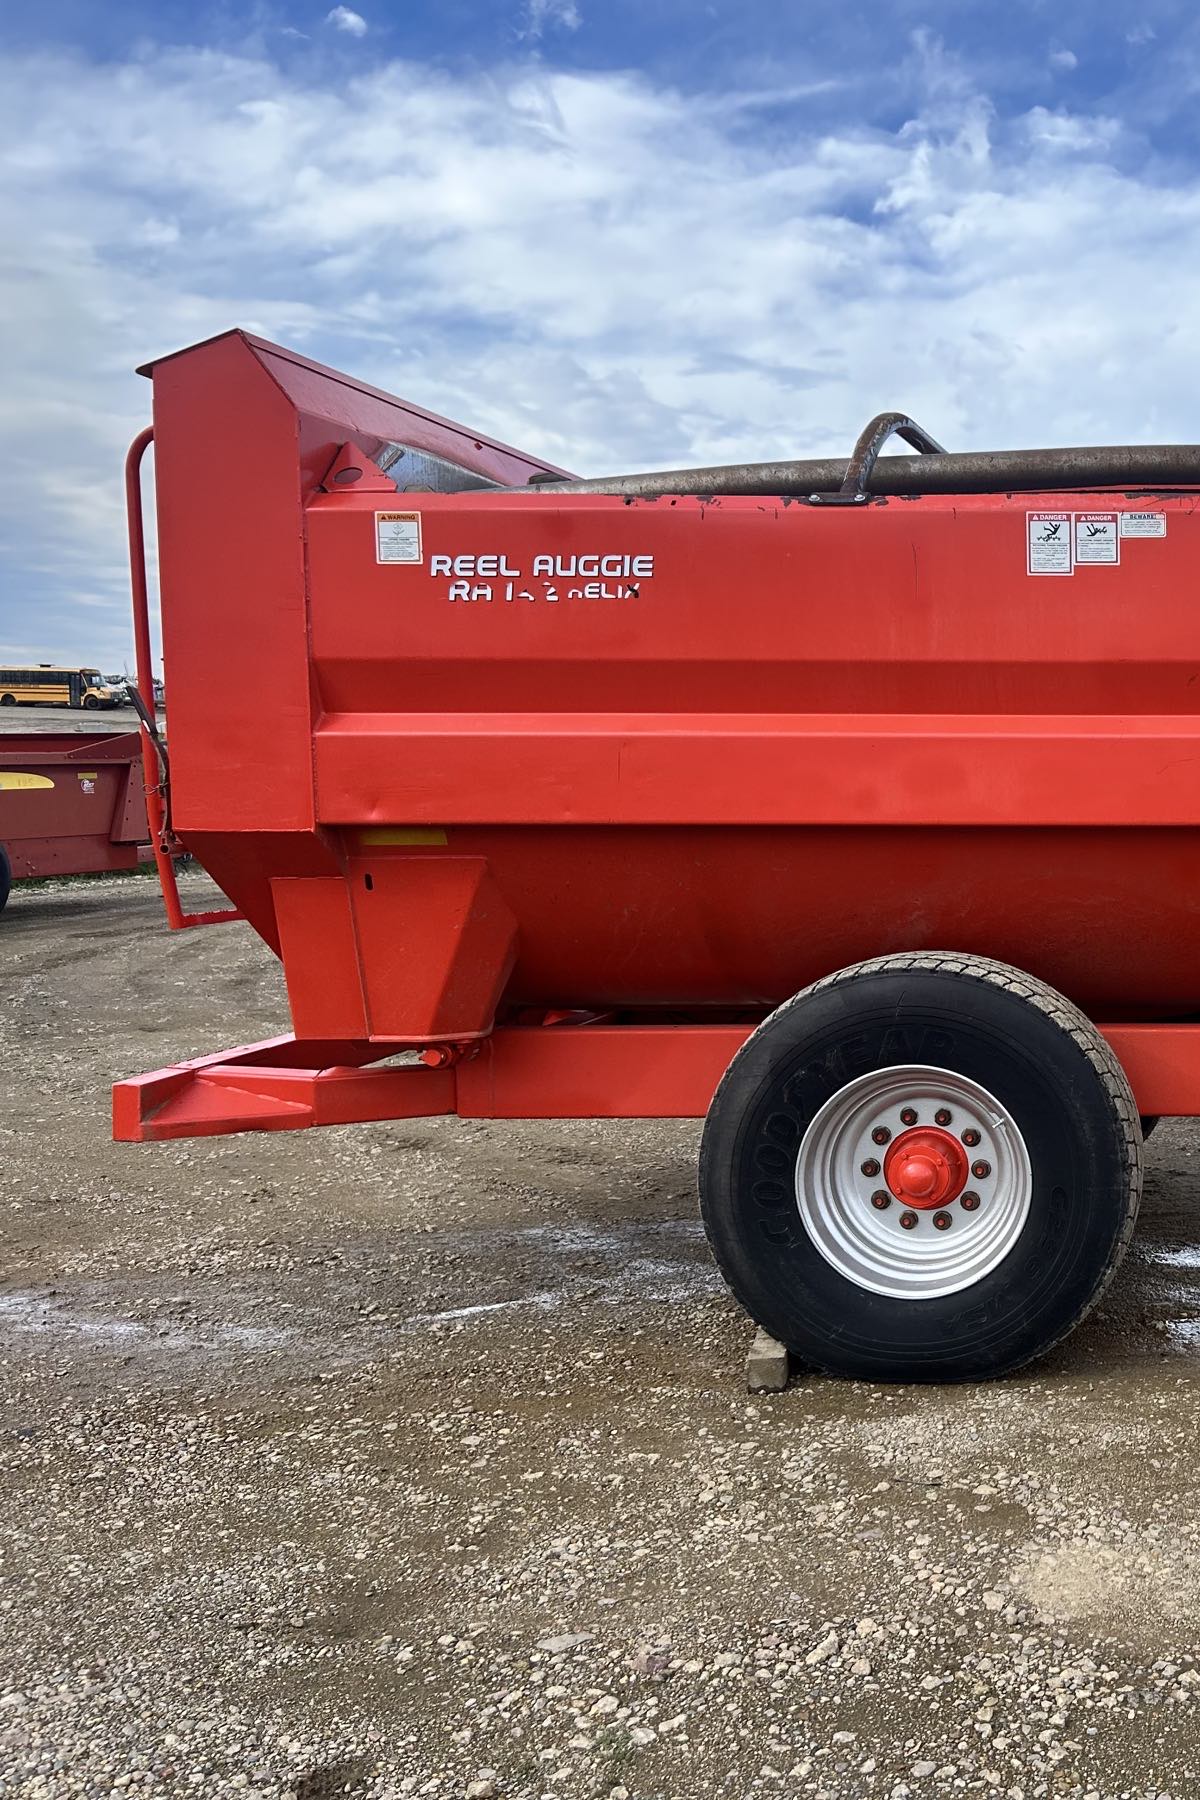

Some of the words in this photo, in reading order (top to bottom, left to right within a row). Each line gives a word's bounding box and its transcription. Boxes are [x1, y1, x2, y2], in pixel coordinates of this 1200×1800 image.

[430, 555, 521, 577] REEL
[533, 555, 654, 577] AUGGIE
[449, 580, 492, 602] RA
